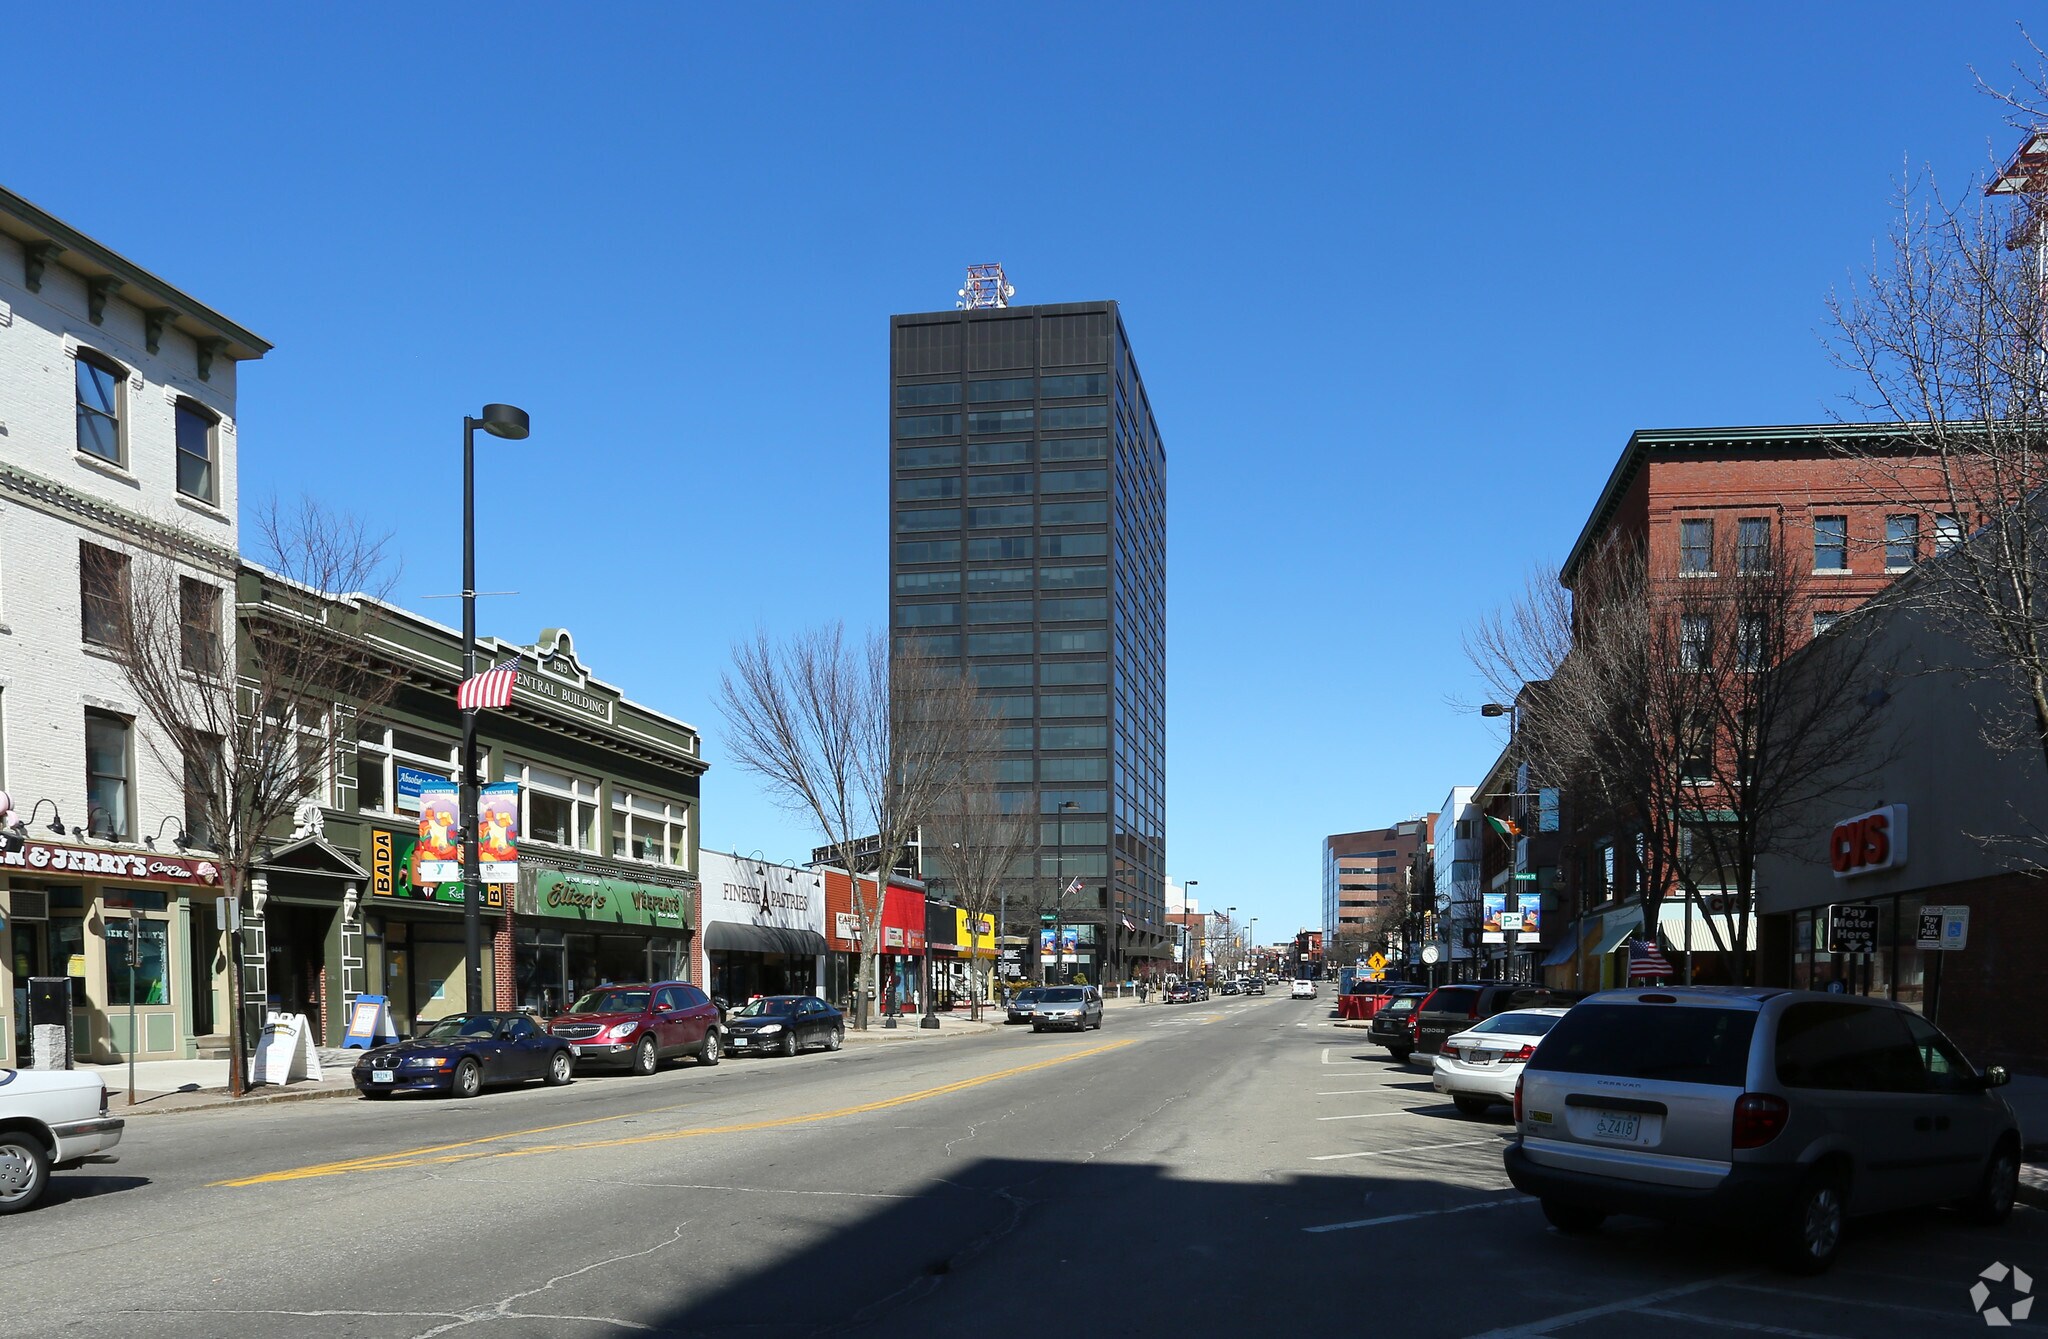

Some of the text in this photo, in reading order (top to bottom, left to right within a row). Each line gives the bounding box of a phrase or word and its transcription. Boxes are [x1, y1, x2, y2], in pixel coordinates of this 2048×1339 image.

[553, 660, 568, 674] 1913
[561, 688, 605, 716] BUILDING
[1831, 815, 1888, 872] CVS
[28, 846, 50, 868] &
[51, 848, 148, 878] JERRY'S
[376, 834, 391, 893] BADA
[546, 881, 607, 909] Eliza's
[723, 882, 809, 912] FINESSE PASTRIES
[1842, 907, 1867, 919] Pay
[1923, 915, 1938, 924] Pay
[1833, 917, 1874, 929] Meter
[1925, 922, 1936, 930] To
[1837, 928, 1871, 940] Here
[1920, 928, 1939, 936] Park
[1597, 1079, 1642, 1089] CARAVAN
[1607, 1119, 1634, 1136] Z418
